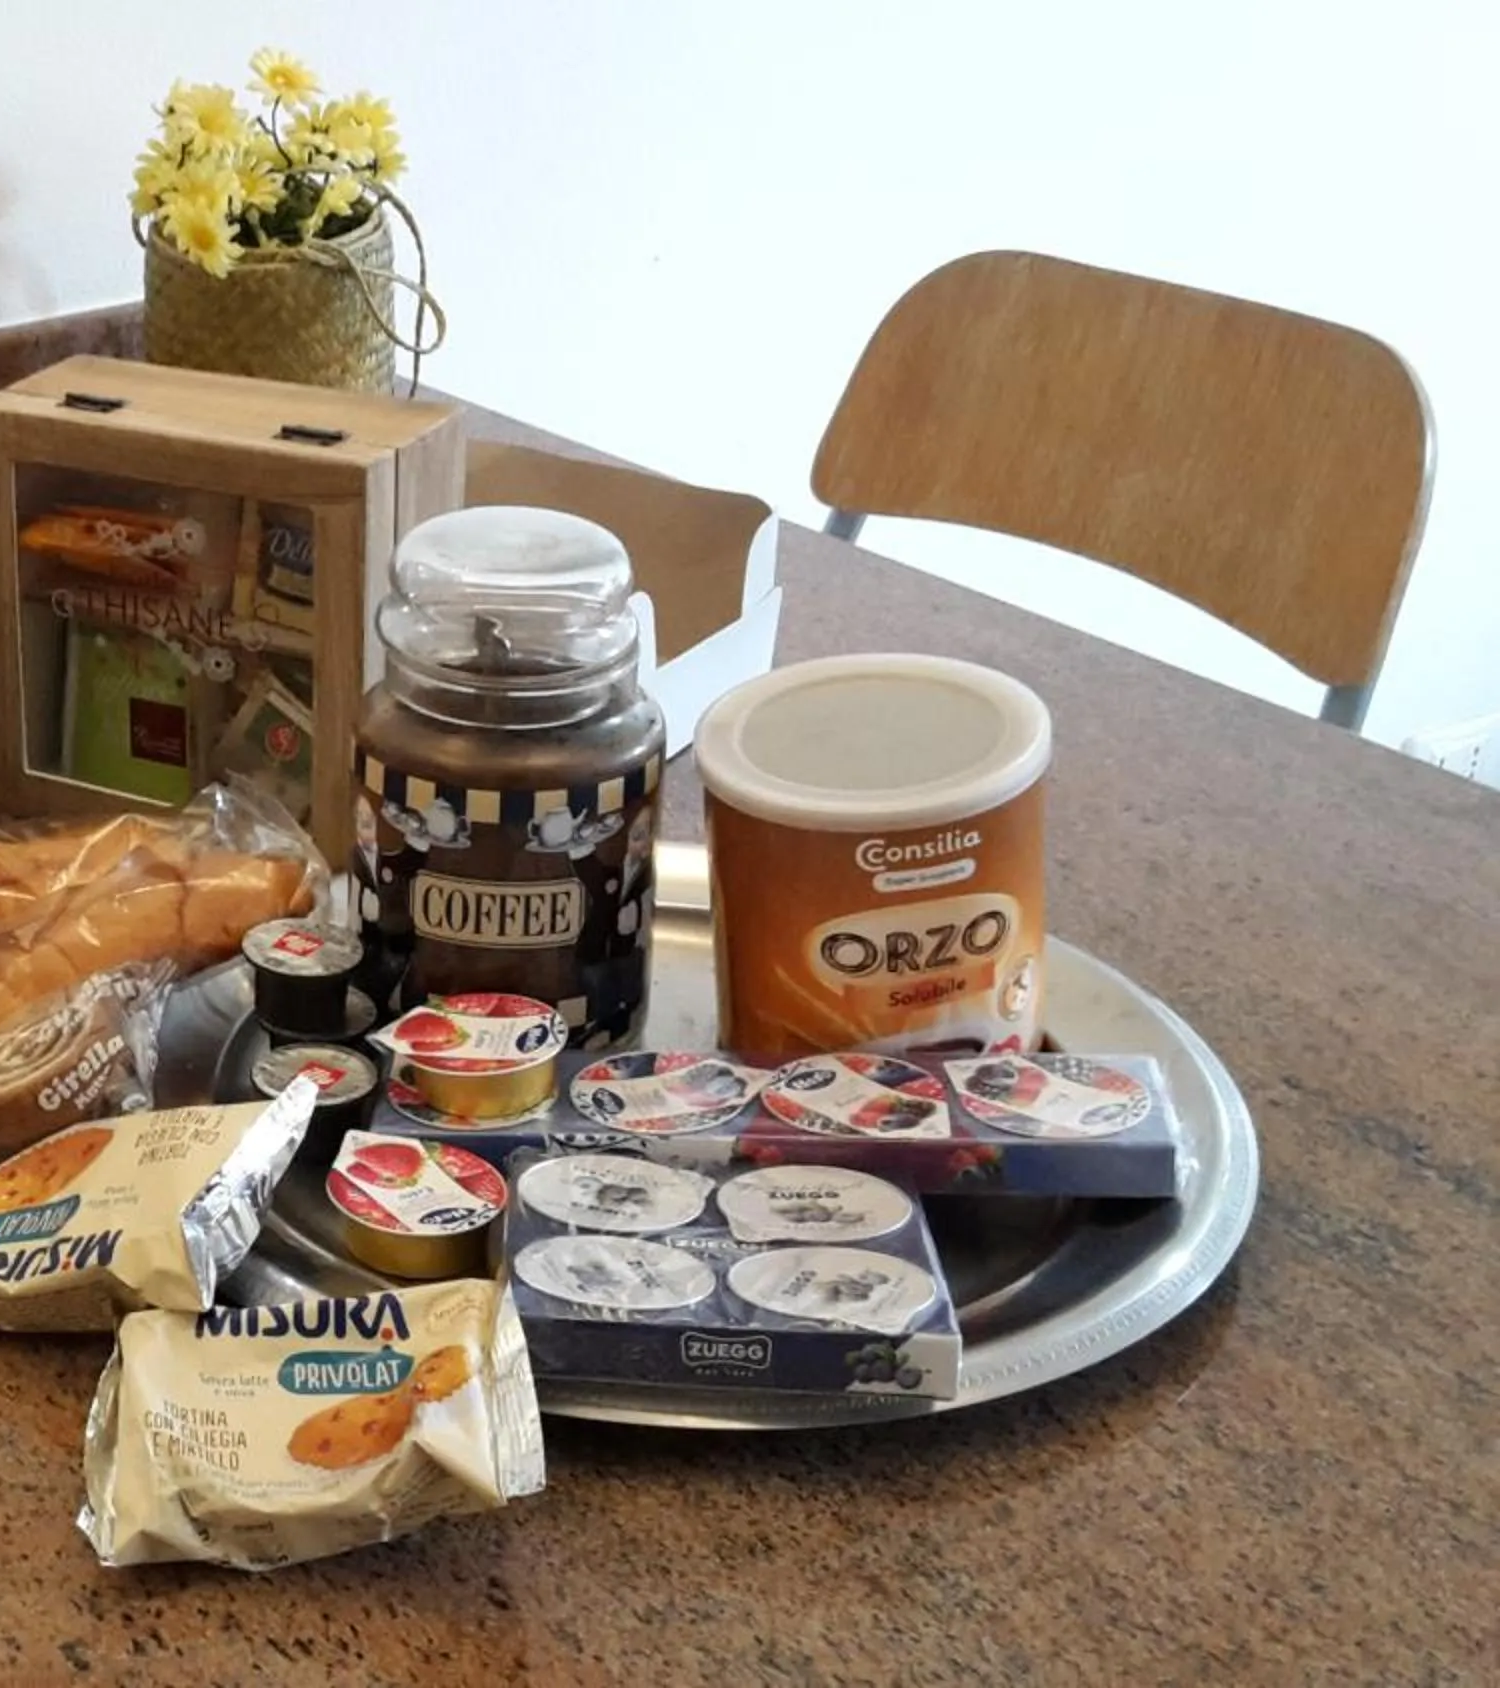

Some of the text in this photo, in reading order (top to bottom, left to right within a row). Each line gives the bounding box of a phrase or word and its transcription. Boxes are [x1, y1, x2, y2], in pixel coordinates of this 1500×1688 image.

[855, 831, 981, 873] Consilia
[421, 884, 572, 937] COFFEE
[820, 910, 1009, 975] ORZO
[888, 977, 968, 1008] Solubile
[37, 1035, 125, 1112] Girella
[194, 1293, 411, 1341] MISURA
[687, 1341, 764, 1360] ZUEGG
[293, 1359, 402, 1390] PRIVOLAT
[143, 1410, 175, 1432] CON
[163, 1399, 229, 1428] TORTINA
